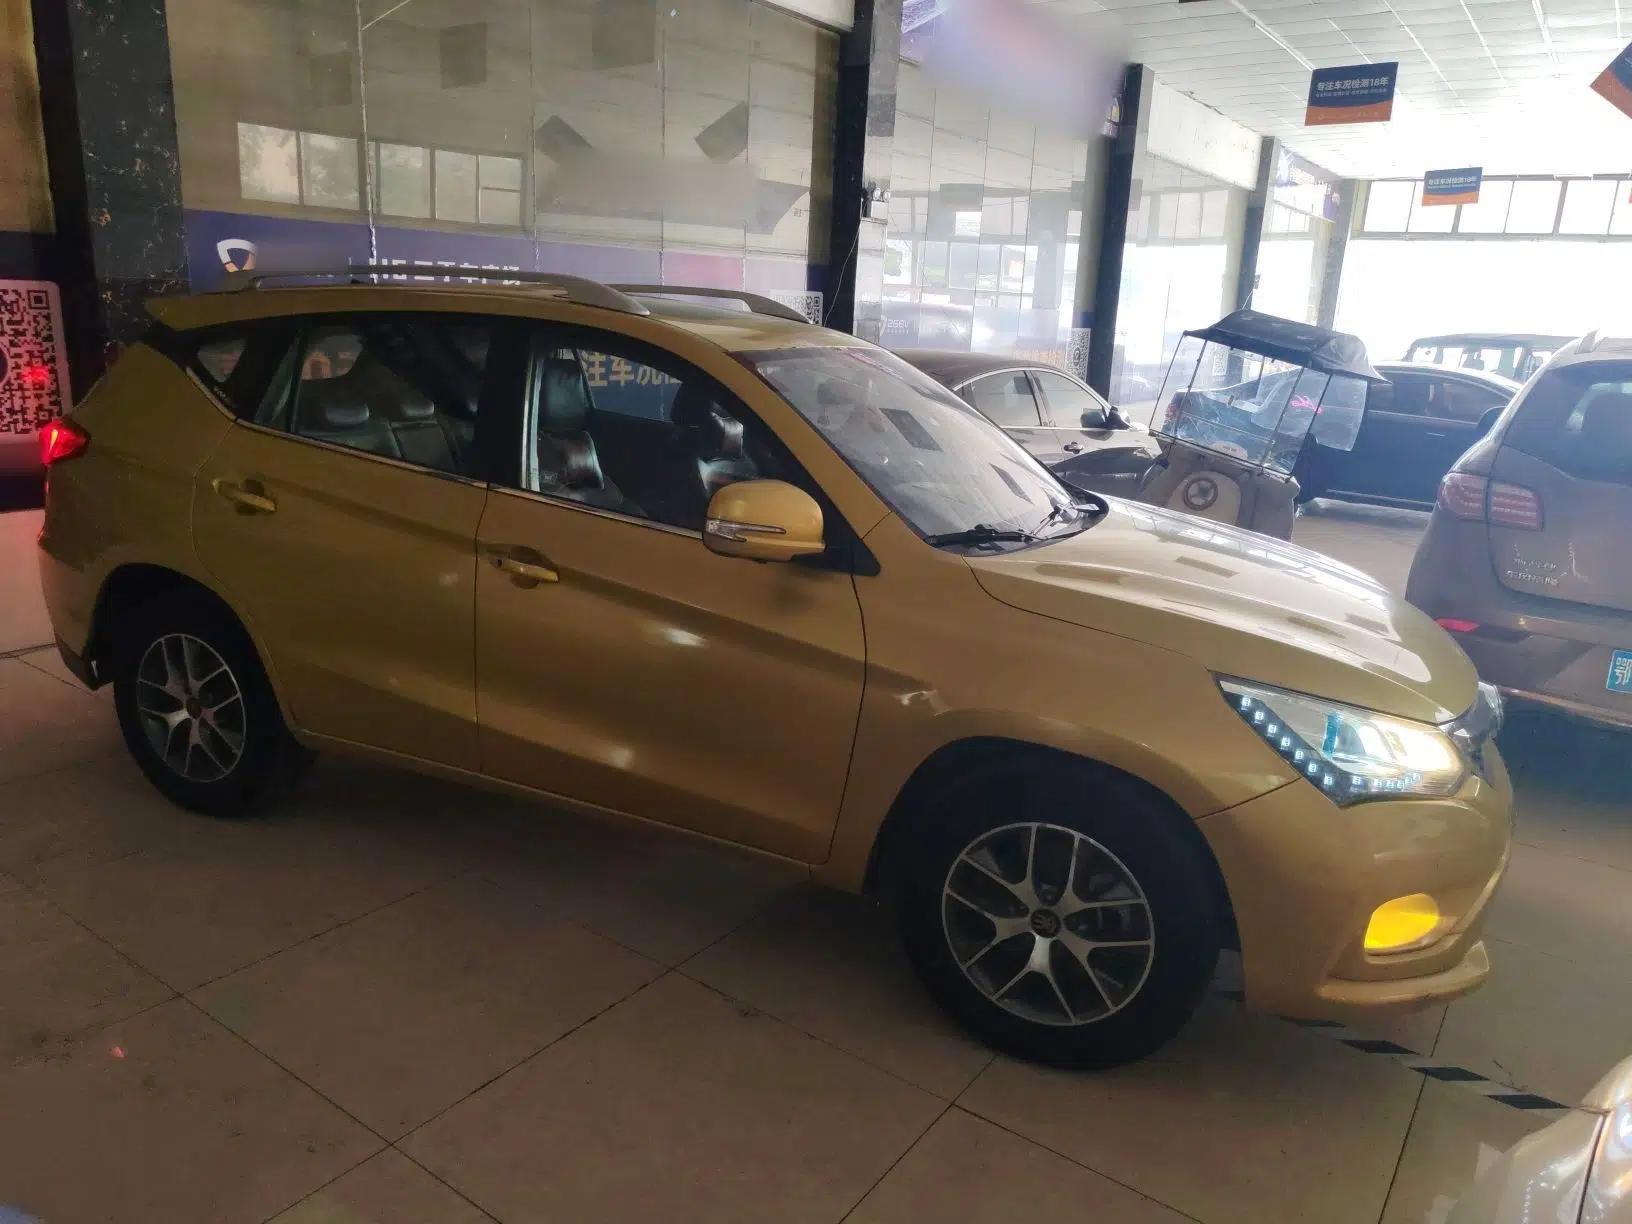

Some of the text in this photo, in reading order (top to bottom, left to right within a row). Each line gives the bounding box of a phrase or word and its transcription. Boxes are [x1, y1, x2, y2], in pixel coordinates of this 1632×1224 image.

[1317, 77, 1389, 91] 专注车况检测18年
